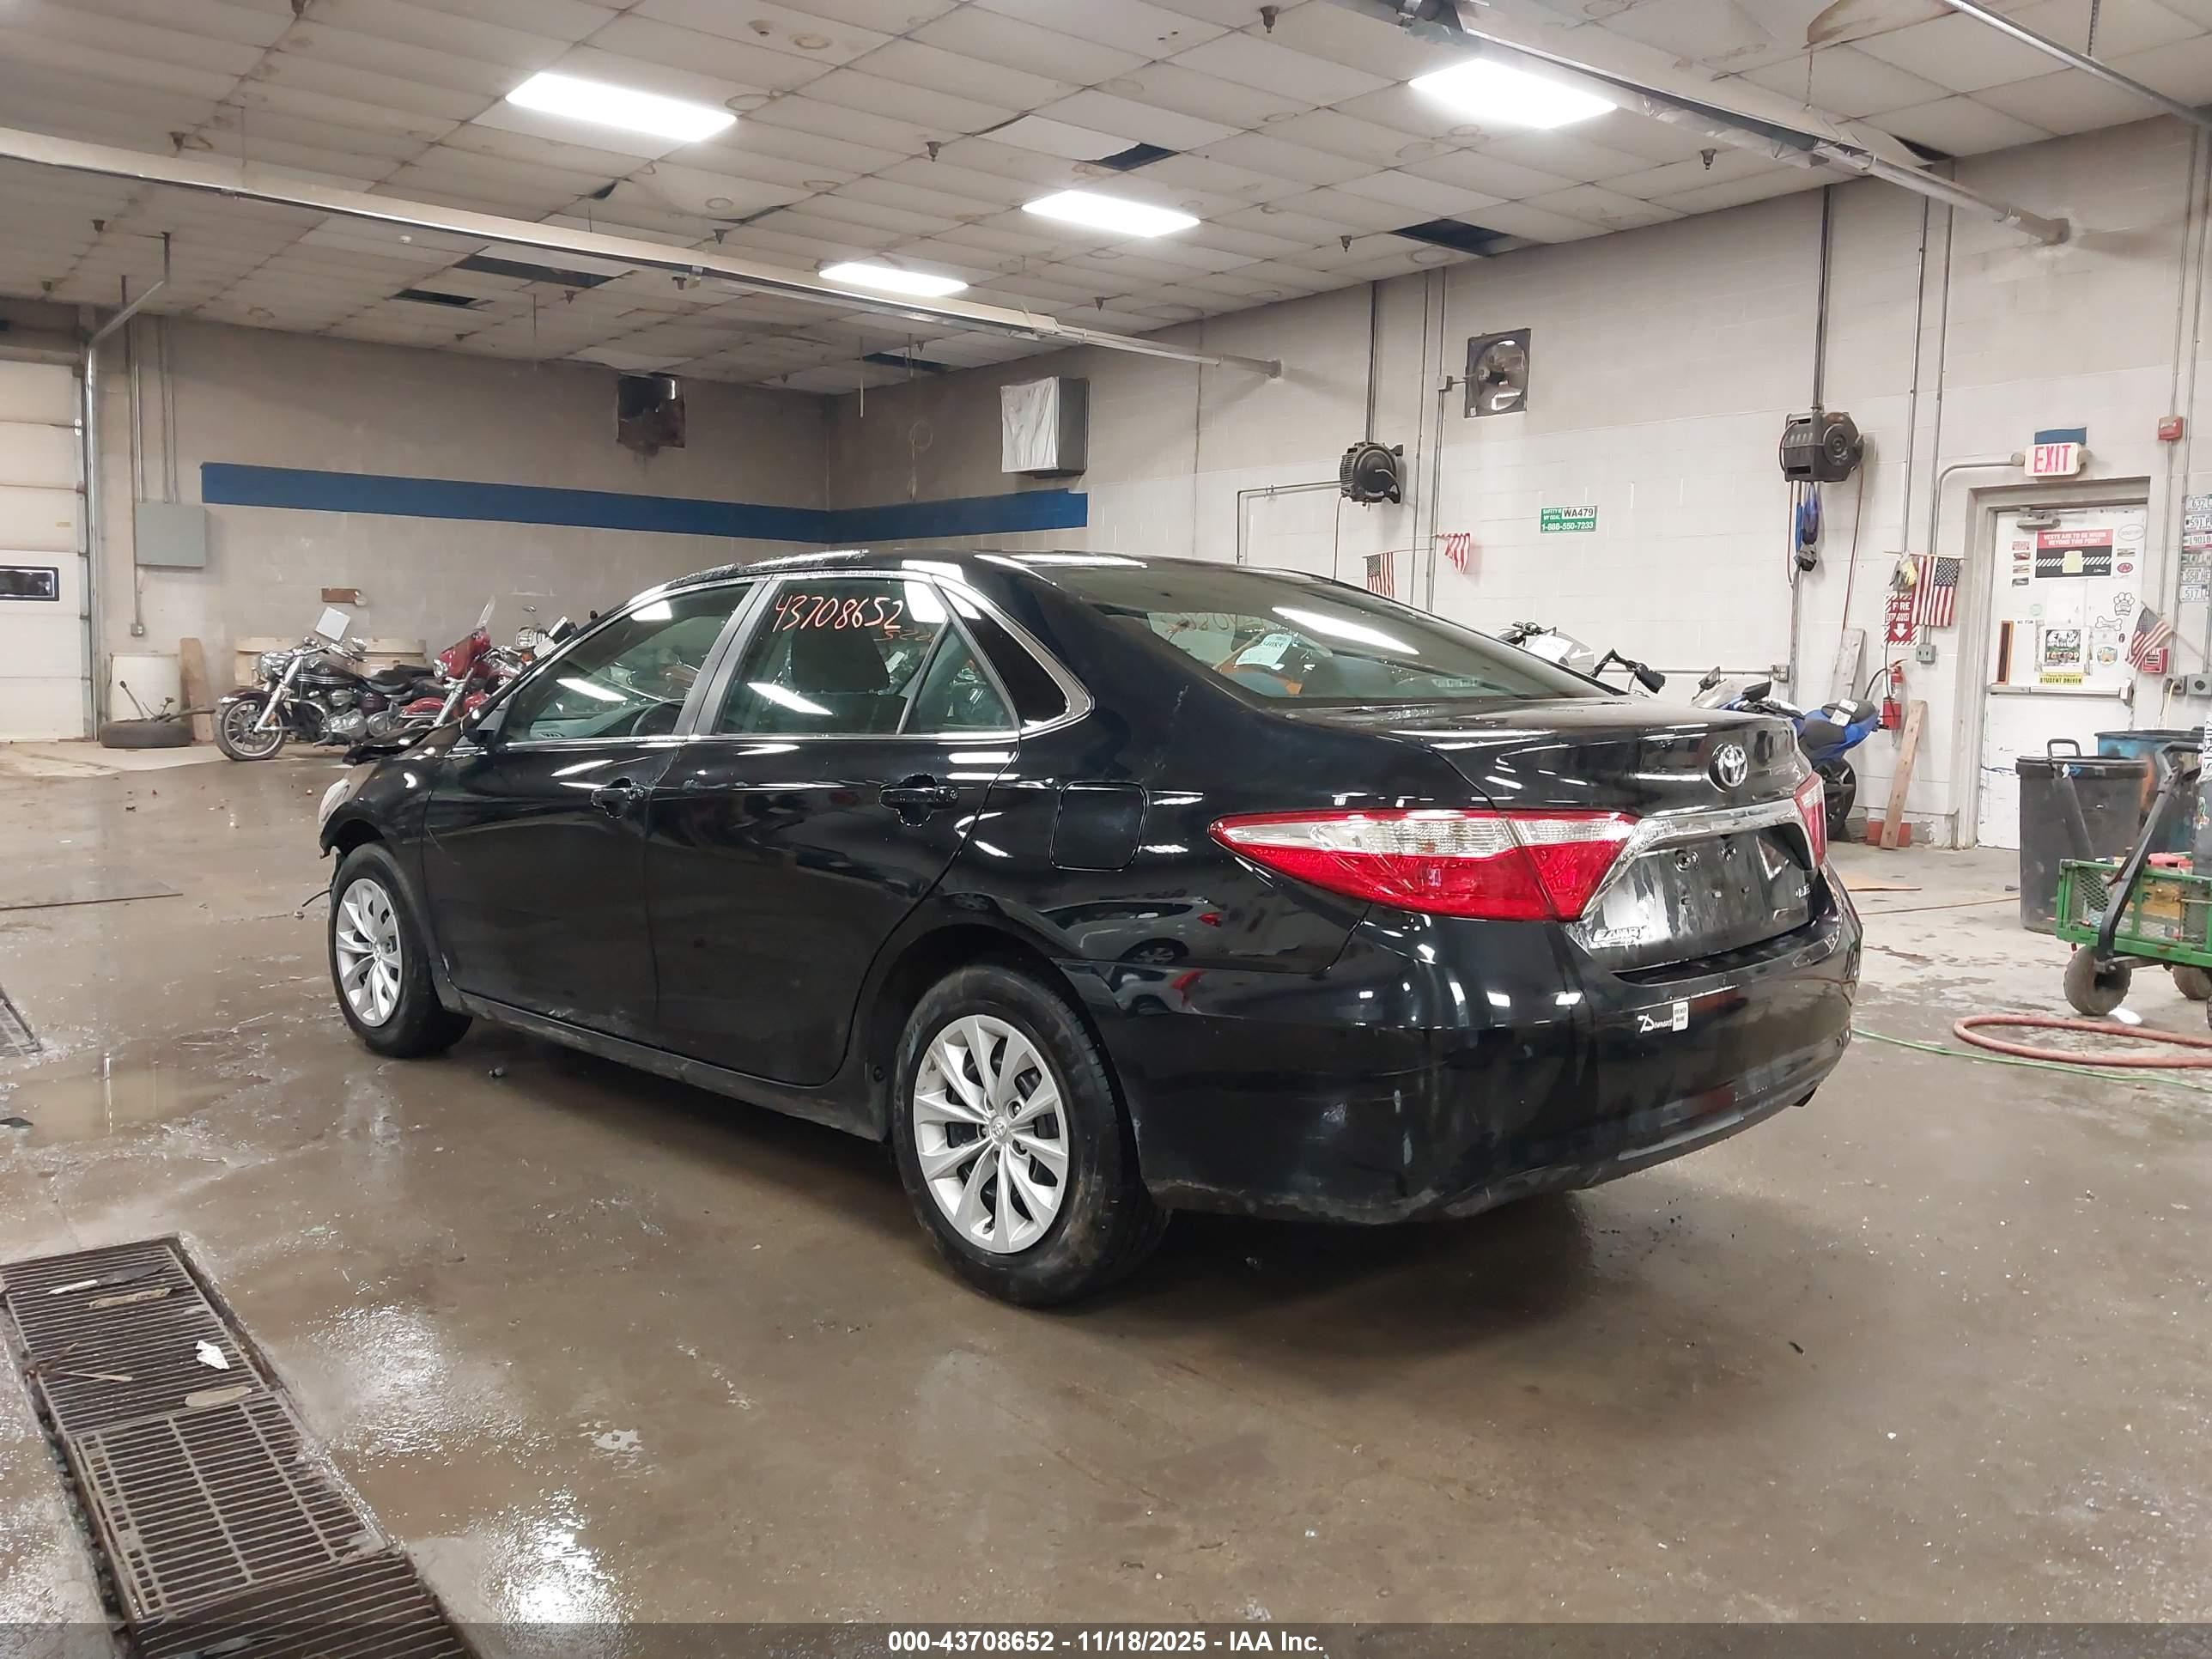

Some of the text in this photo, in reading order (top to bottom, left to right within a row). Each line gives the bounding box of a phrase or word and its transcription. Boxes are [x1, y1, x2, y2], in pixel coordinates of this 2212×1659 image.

[2033, 445, 2071, 473] EXIT
[1564, 507, 1594, 517] WA479
[772, 592, 903, 633] 43708652
[1892, 601, 1911, 611] FRE
